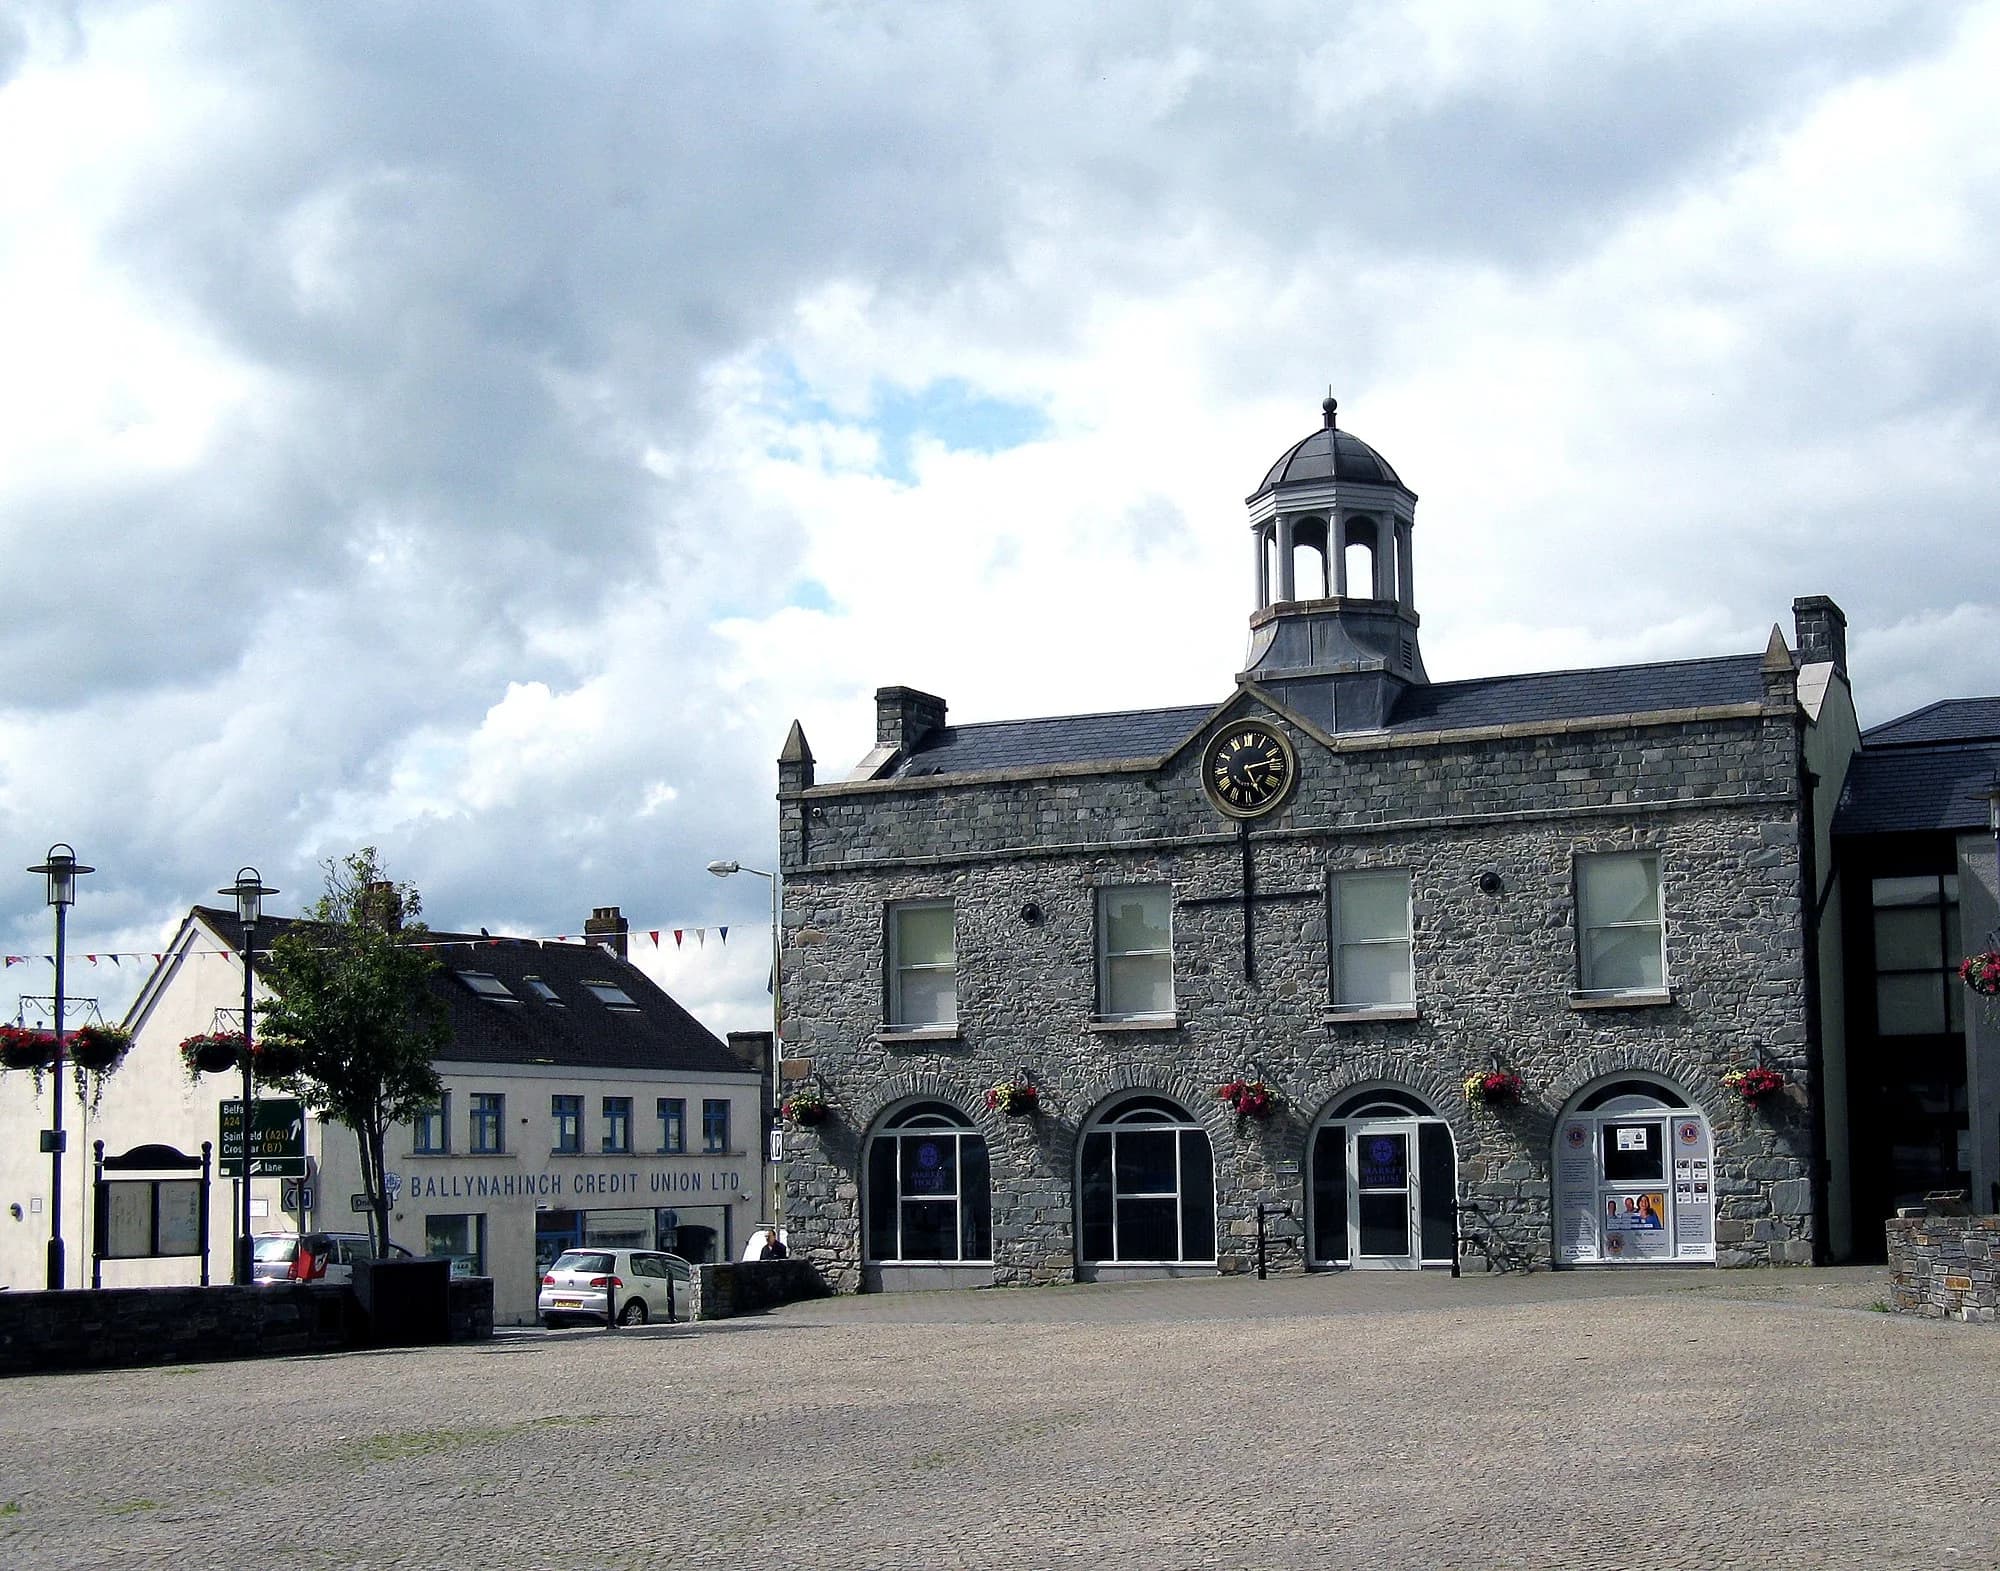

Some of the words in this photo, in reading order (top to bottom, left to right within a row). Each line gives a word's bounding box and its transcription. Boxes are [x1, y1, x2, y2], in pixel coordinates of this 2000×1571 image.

[223, 1104, 244, 1114] Belfa
[223, 1130, 262, 1142] Sainteld
[223, 1144, 259, 1154] Crosar
[411, 1174, 561, 1198] BALLYNAHINCH
[573, 1173, 638, 1194] CREDIT
[650, 1172, 701, 1192] UNION
[711, 1171, 739, 1191] LTD
